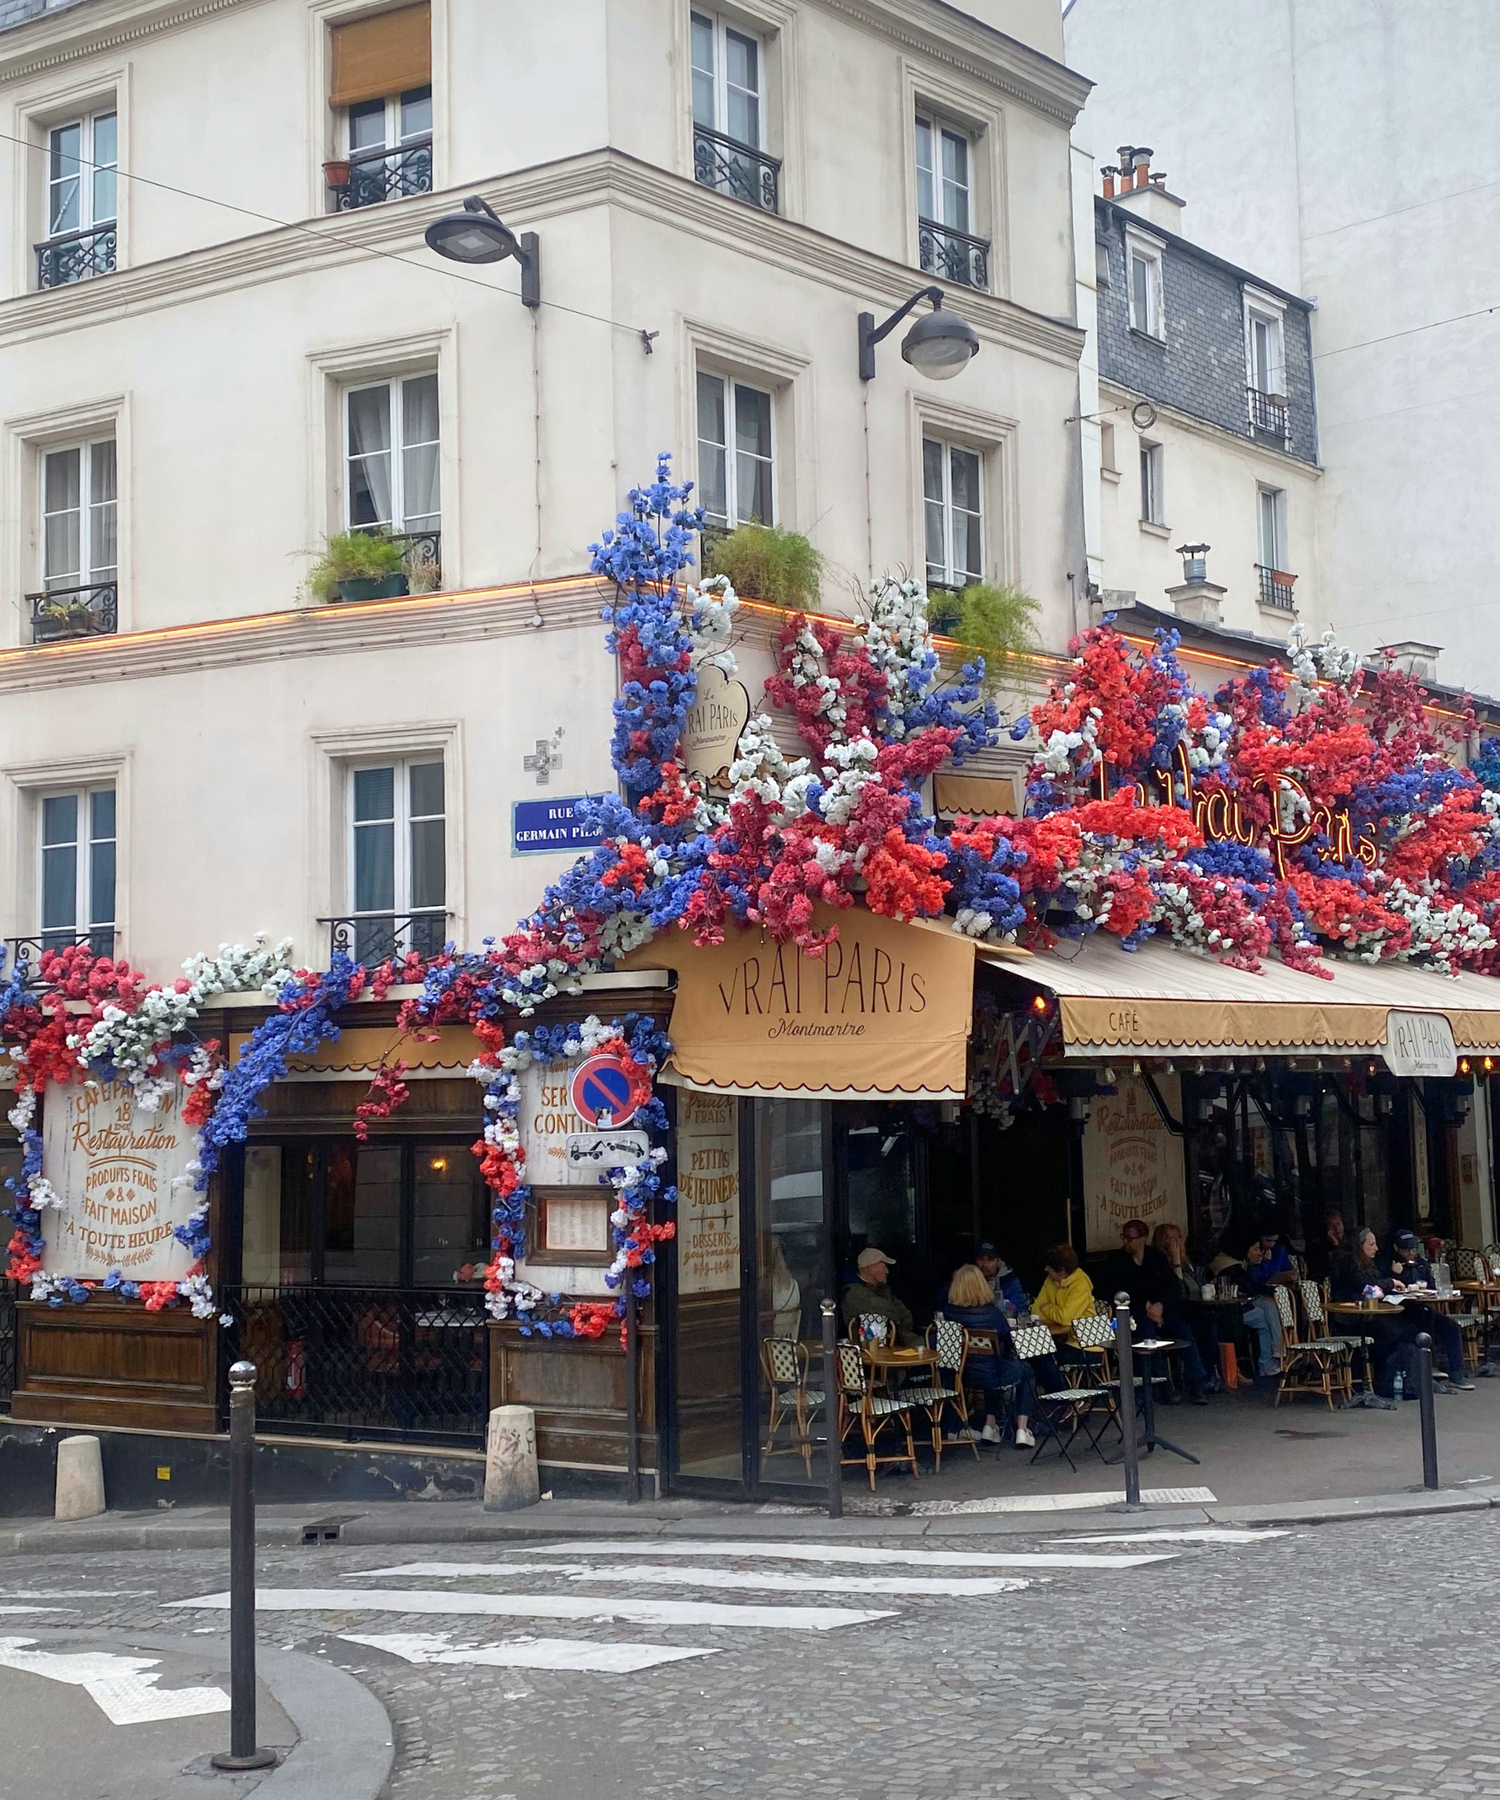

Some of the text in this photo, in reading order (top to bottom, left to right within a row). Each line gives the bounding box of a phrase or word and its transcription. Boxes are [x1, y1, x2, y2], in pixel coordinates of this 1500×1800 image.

[684, 703, 738, 735] RAI PARIS
[548, 807, 574, 820] RUE
[516, 826, 603, 842] GERMAIN PILO
[718, 940, 926, 1015] VRAI PARIS
[768, 1017, 866, 1039] Montmartre
[1109, 1010, 1138, 1031] CAFÉ
[1419, 1018, 1451, 1059] PARIS
[115, 1102, 131, 1121] 18
[694, 1110, 726, 1124] FRAIS
[72, 1121, 179, 1156] Restauration
[691, 1148, 730, 1171] PETITS
[86, 1167, 158, 1193] PRODUITS FRAIS
[116, 1186, 124, 1202] &
[84, 1196, 157, 1226] FAIT MAISON
[1109, 1199, 1139, 1219] TOUTE
[79, 1225, 125, 1249] TOUTE
[128, 1221, 173, 1248] HEURE
[692, 1231, 732, 1249] DESSERTS
